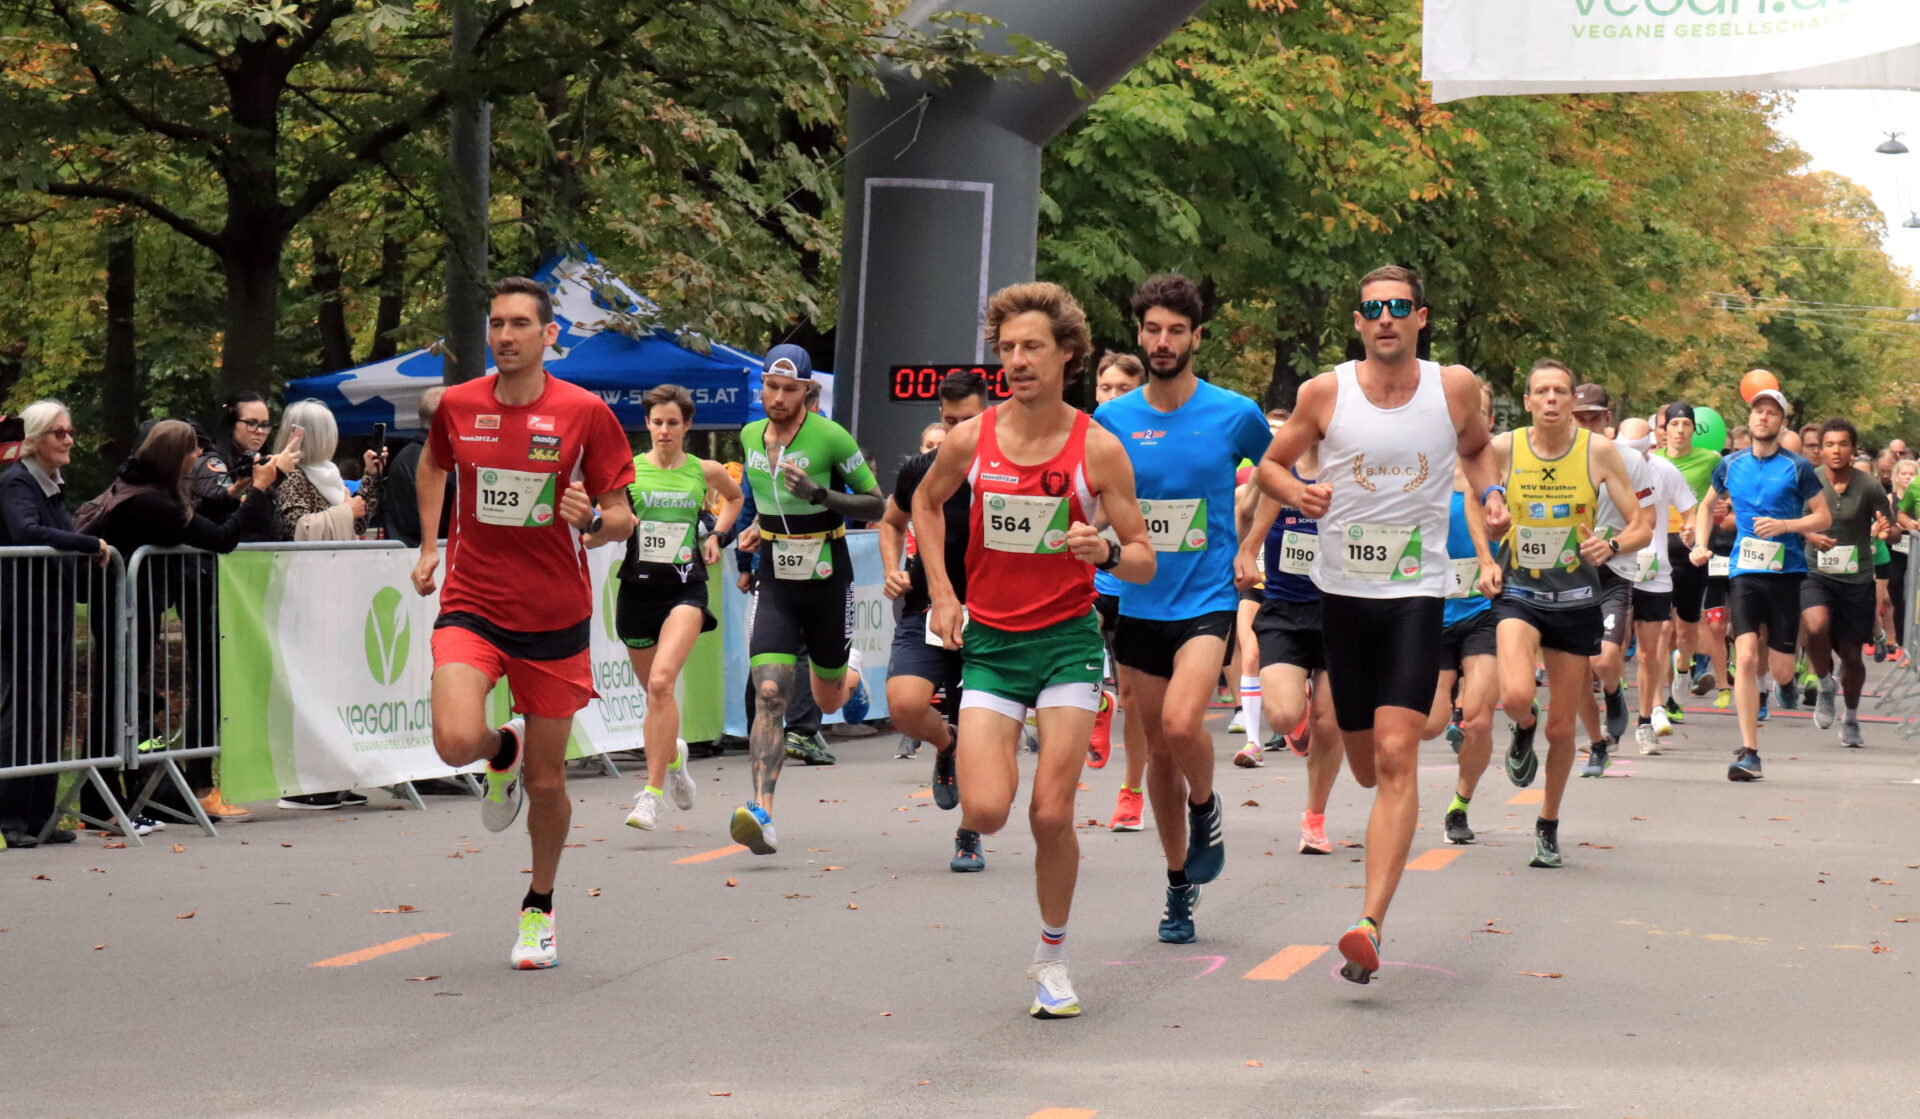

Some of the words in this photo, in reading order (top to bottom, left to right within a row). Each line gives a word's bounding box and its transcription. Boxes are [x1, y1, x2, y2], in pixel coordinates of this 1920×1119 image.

[1572, 24, 1665, 39] VEGANE
[1674, 12, 1849, 37] GESELLSCHAFT
[1366, 465, 1417, 476] B.N.O.C.
[1520, 483, 1538, 491] HSV
[1539, 483, 1577, 491] Marathon
[482, 488, 519, 508] 1123
[991, 514, 1031, 533] 564
[644, 536, 666, 548] 319
[1521, 542, 1546, 555] 461
[1285, 546, 1315, 562] 1190
[1348, 544, 1387, 562] 1183
[1743, 549, 1765, 562] 1154
[778, 554, 804, 567] 367
[1821, 556, 1840, 566] 329
